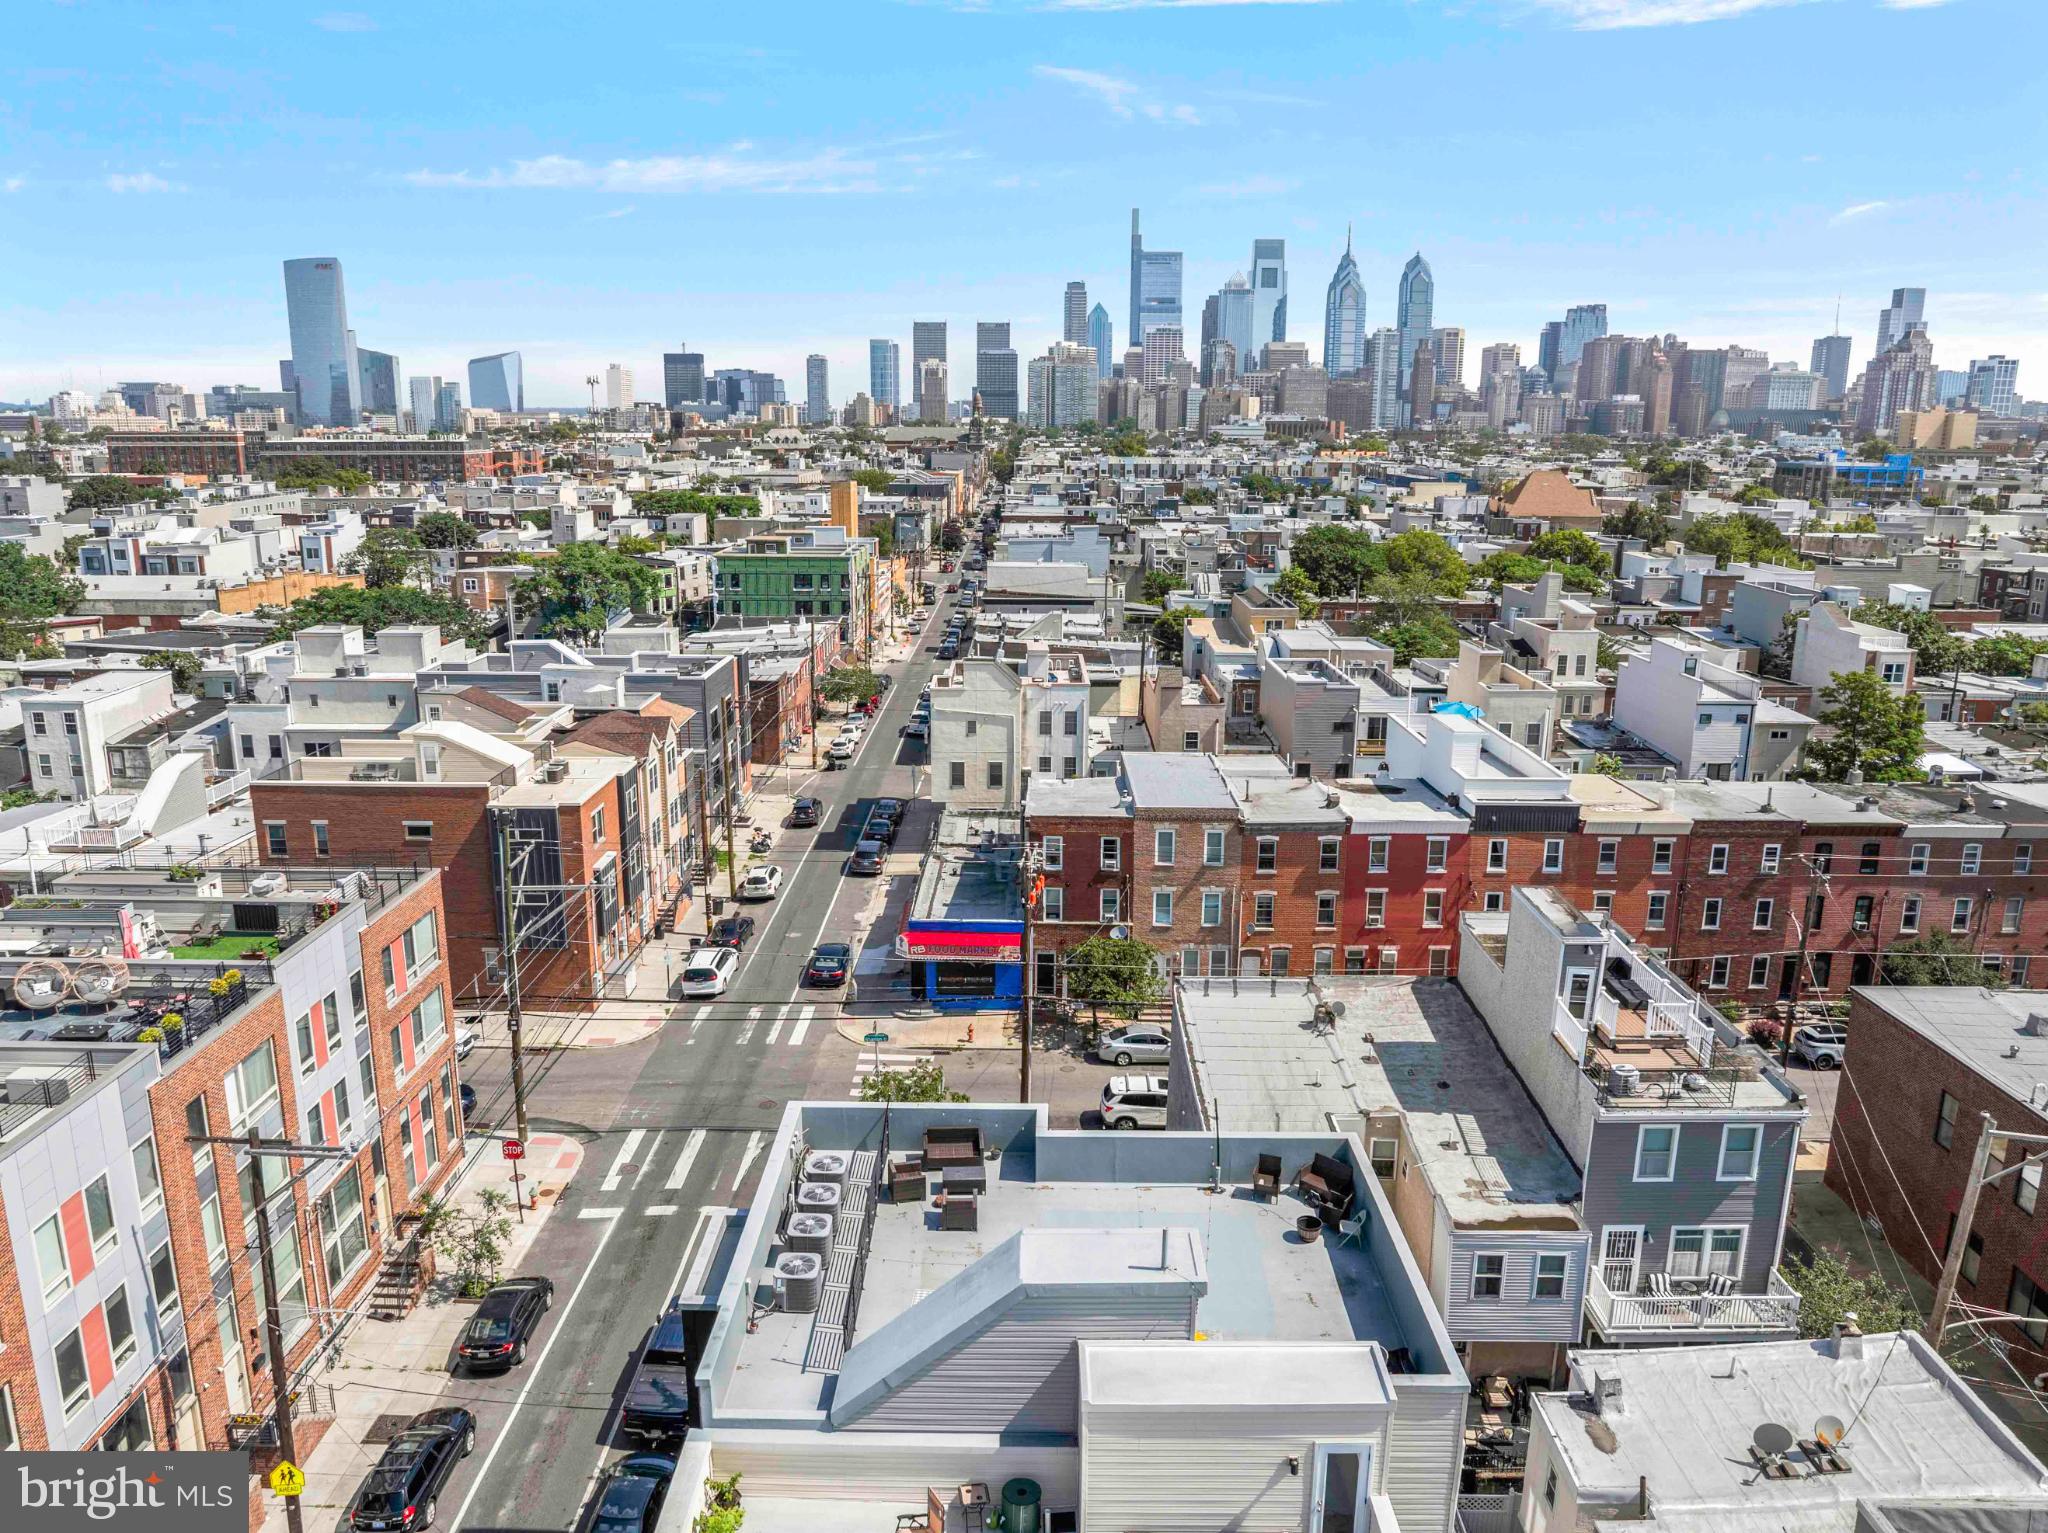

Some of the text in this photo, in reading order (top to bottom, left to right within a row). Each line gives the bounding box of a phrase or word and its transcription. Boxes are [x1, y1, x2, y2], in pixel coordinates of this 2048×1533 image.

[910, 945, 926, 954] RB
[928, 945, 957, 955] FOOD
[959, 945, 999, 955] MARKET
[503, 1146, 523, 1155] STOP
